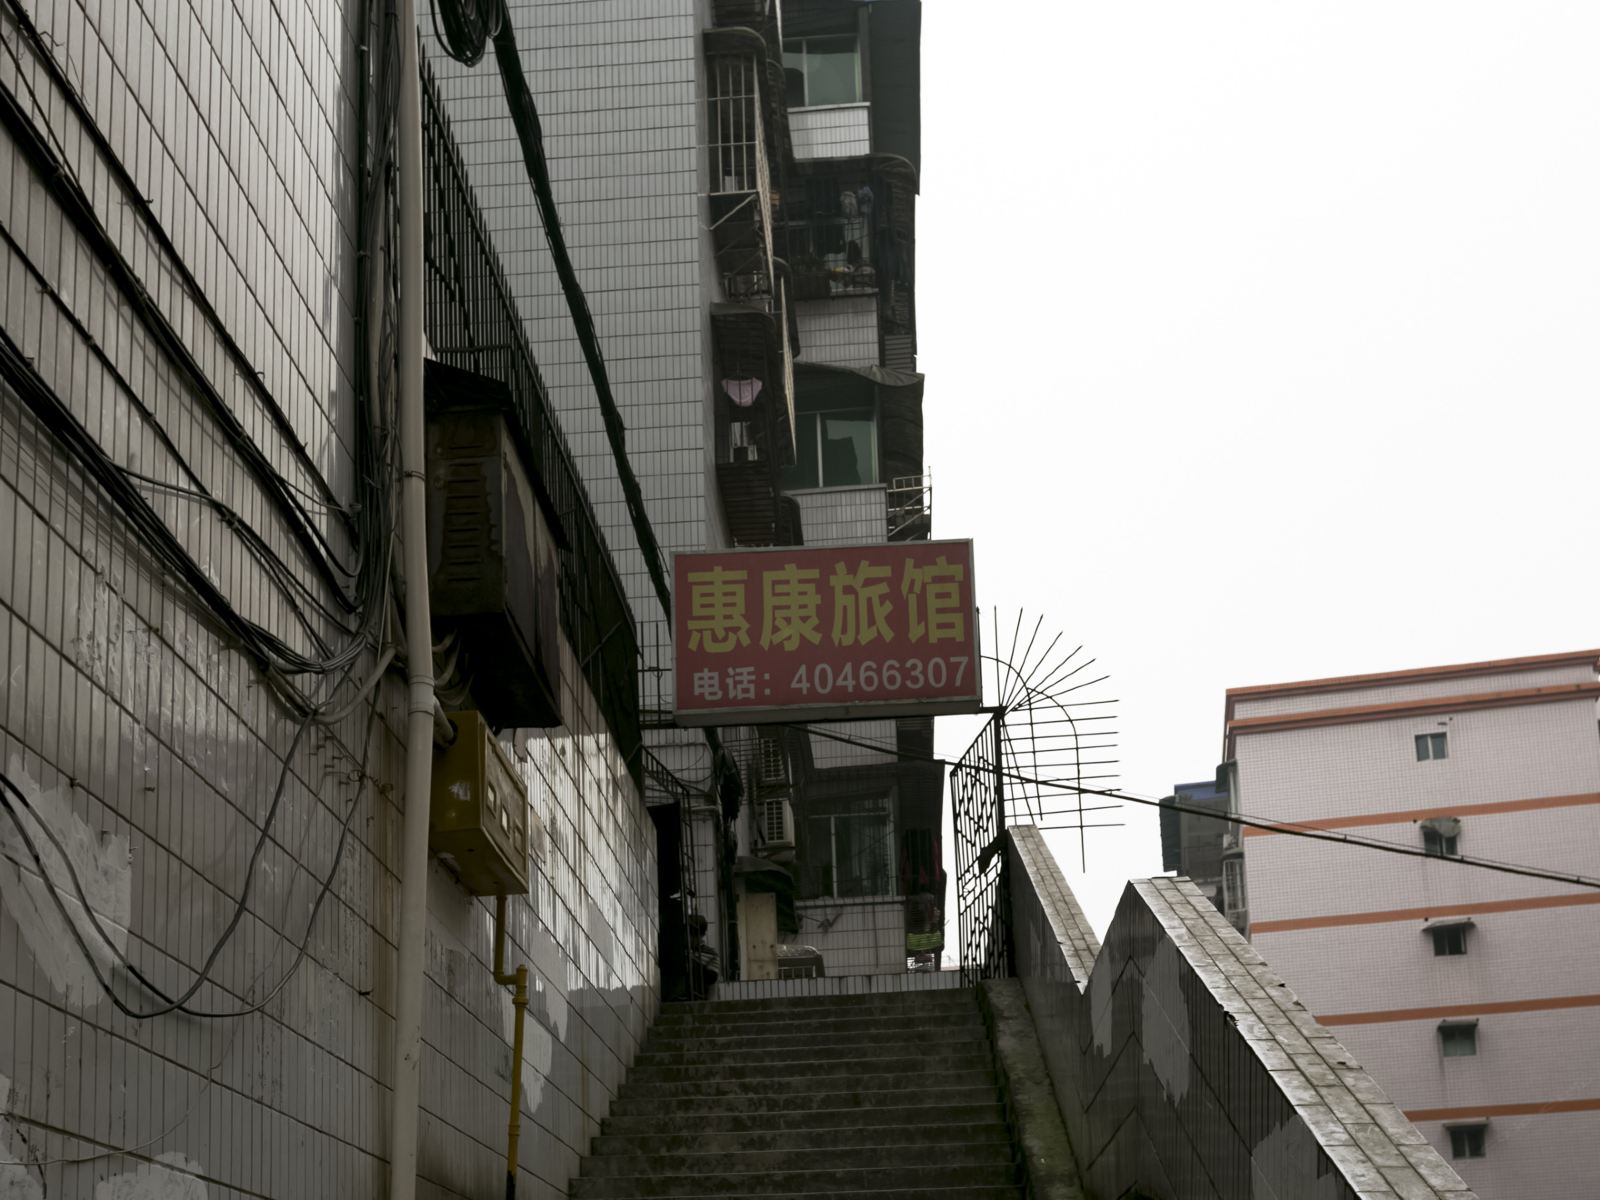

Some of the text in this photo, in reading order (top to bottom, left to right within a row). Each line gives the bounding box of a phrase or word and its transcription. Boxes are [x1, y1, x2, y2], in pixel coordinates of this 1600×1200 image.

[687, 556, 964, 653] 惠康旅馆
[790, 656, 969, 695] 40466307
